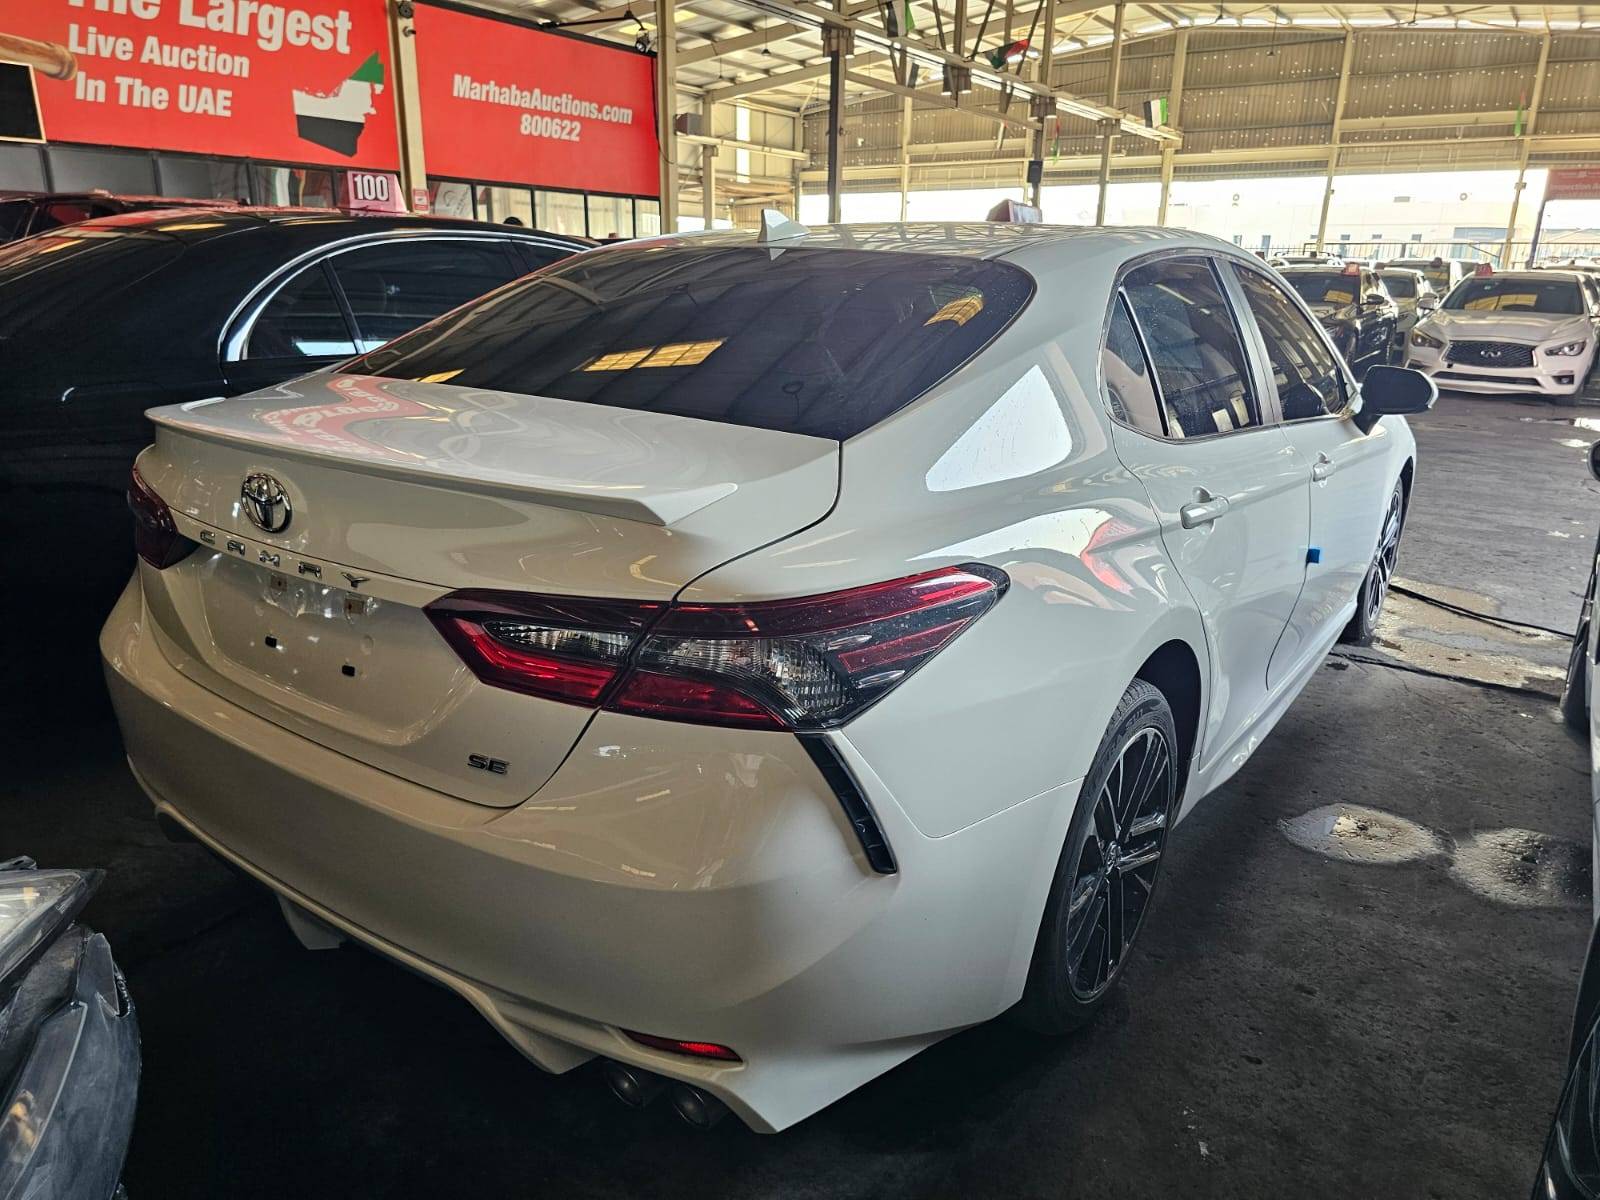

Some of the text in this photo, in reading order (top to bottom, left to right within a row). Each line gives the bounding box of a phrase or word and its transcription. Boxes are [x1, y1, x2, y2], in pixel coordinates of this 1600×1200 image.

[69, 23, 250, 78] Live Auction
[179, 0, 352, 54] Largest
[75, 71, 233, 117] In The UAE
[452, 73, 633, 125] MarhabaAuctions.com
[520, 113, 582, 142] 800622
[354, 174, 389, 201] 100
[200, 529, 371, 588] CAMRY
[467, 753, 510, 775] SE
